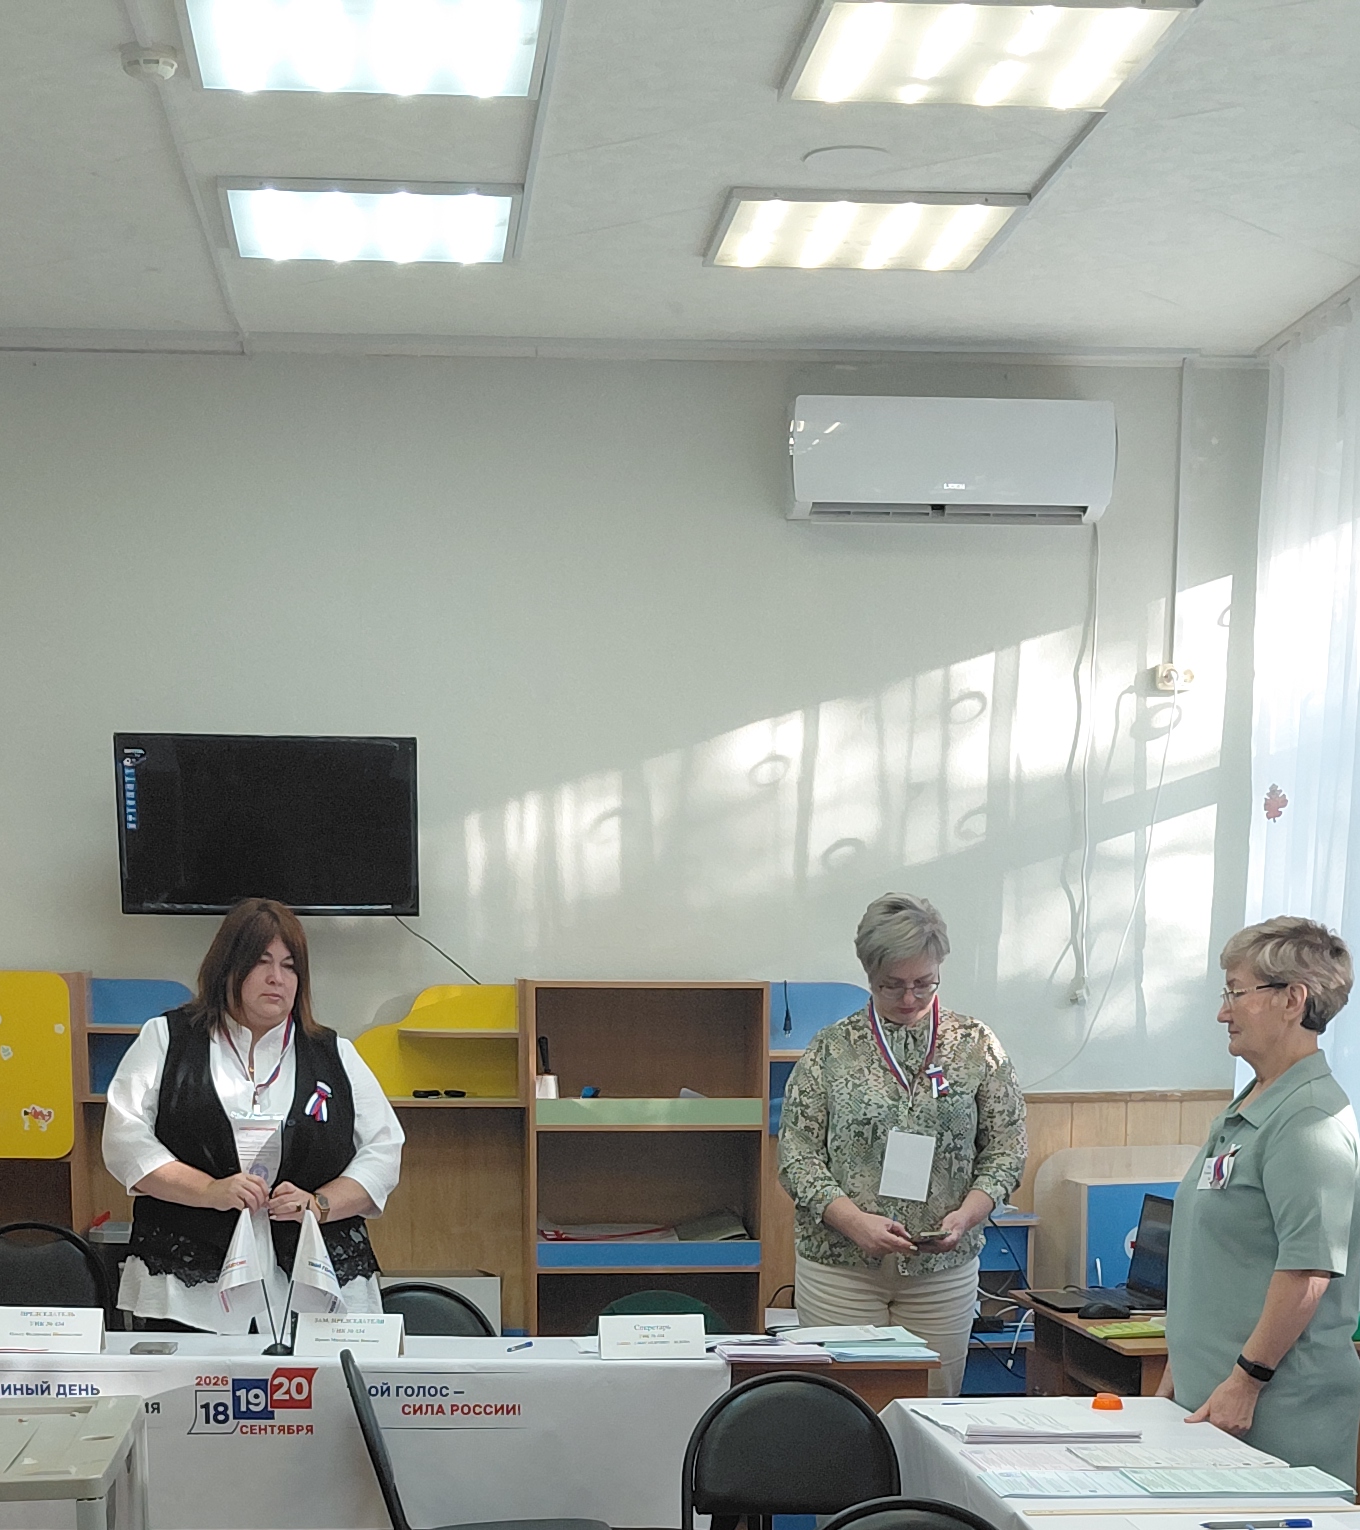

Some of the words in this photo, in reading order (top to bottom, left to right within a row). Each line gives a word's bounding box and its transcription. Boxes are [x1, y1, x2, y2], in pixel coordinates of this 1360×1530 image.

[195, 1376, 229, 1386] 2026
[56, 1383, 101, 1398] ДЕНЬ
[395, 1385, 450, 1398] ГОЛОС
[200, 1402, 230, 1425] 18
[235, 1388, 266, 1412] 19
[272, 1376, 310, 1400] 20
[401, 1404, 446, 1416] СИЛА
[450, 1403, 521, 1416] РОССИИ!
[240, 1424, 314, 1435] СЕНТЯБРЯ
